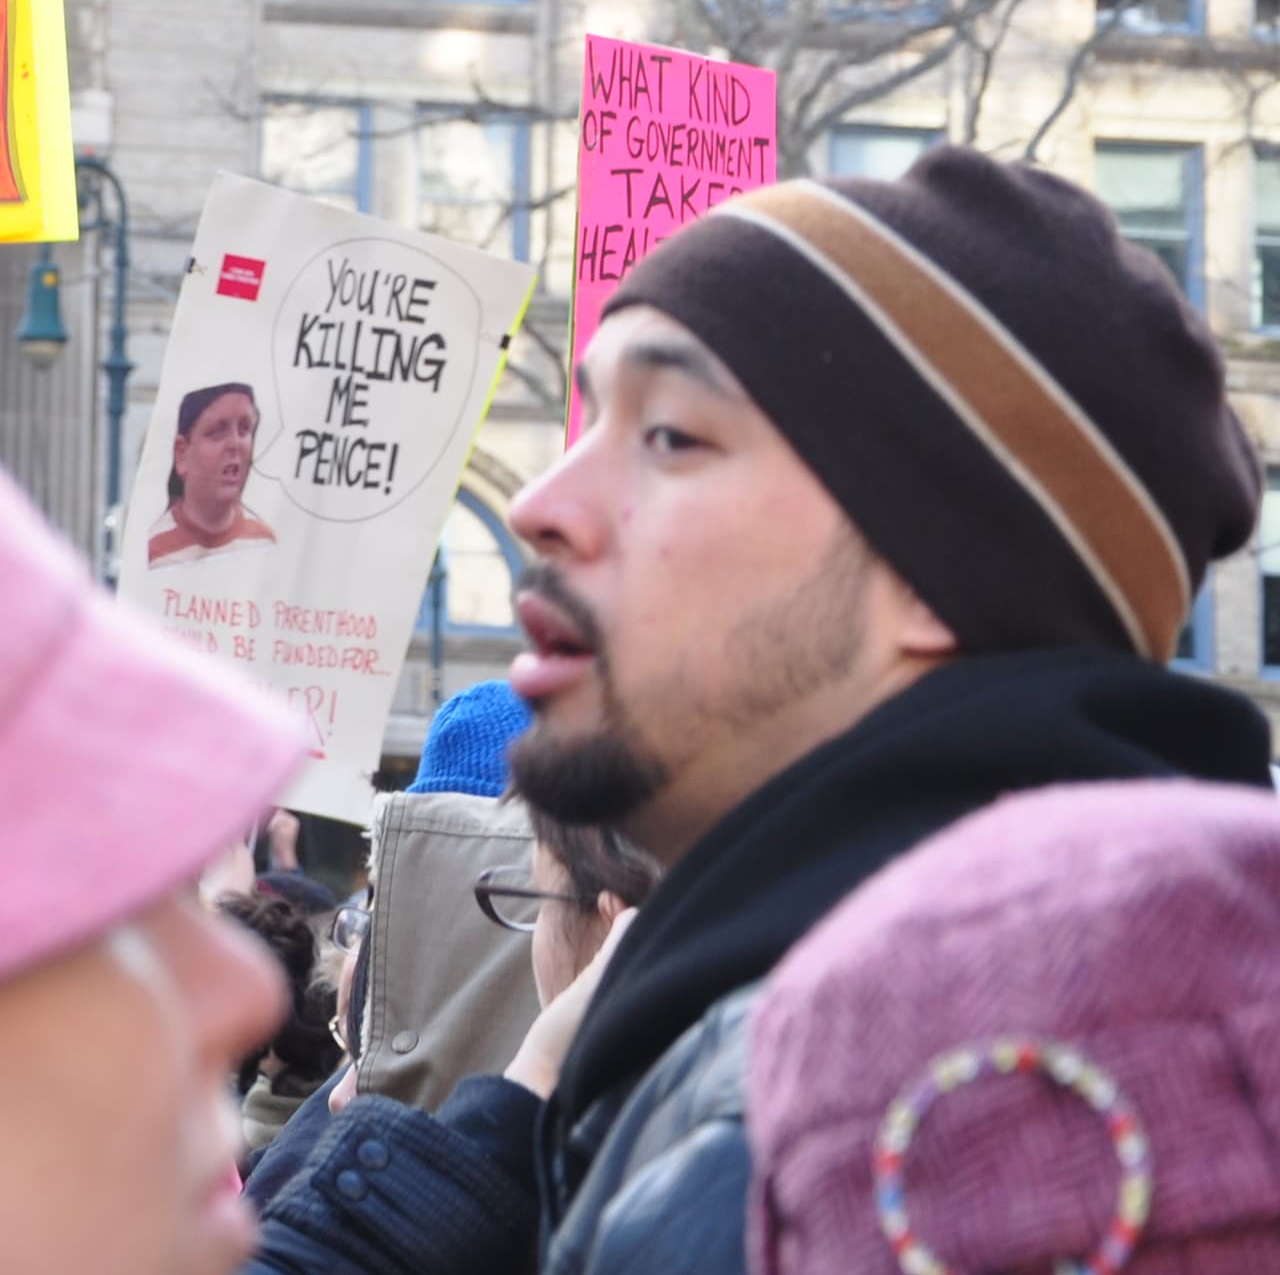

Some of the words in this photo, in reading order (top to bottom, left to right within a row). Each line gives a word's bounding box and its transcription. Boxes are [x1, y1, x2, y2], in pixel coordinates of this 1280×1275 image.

[588, 39, 673, 114] WHAT
[582, 108, 618, 155] OF
[626, 115, 771, 184] GOVERNMENT
[610, 168, 744, 224] TAKE
[325, 257, 438, 325] YOU'RE
[292, 312, 447, 394] KILLING
[325, 375, 370, 428] ME
[294, 429, 400, 496] PENCE!
[162, 587, 262, 630] PLANNED
[272, 600, 378, 641] PARENTHOOD
[232, 634, 257, 662] BE
